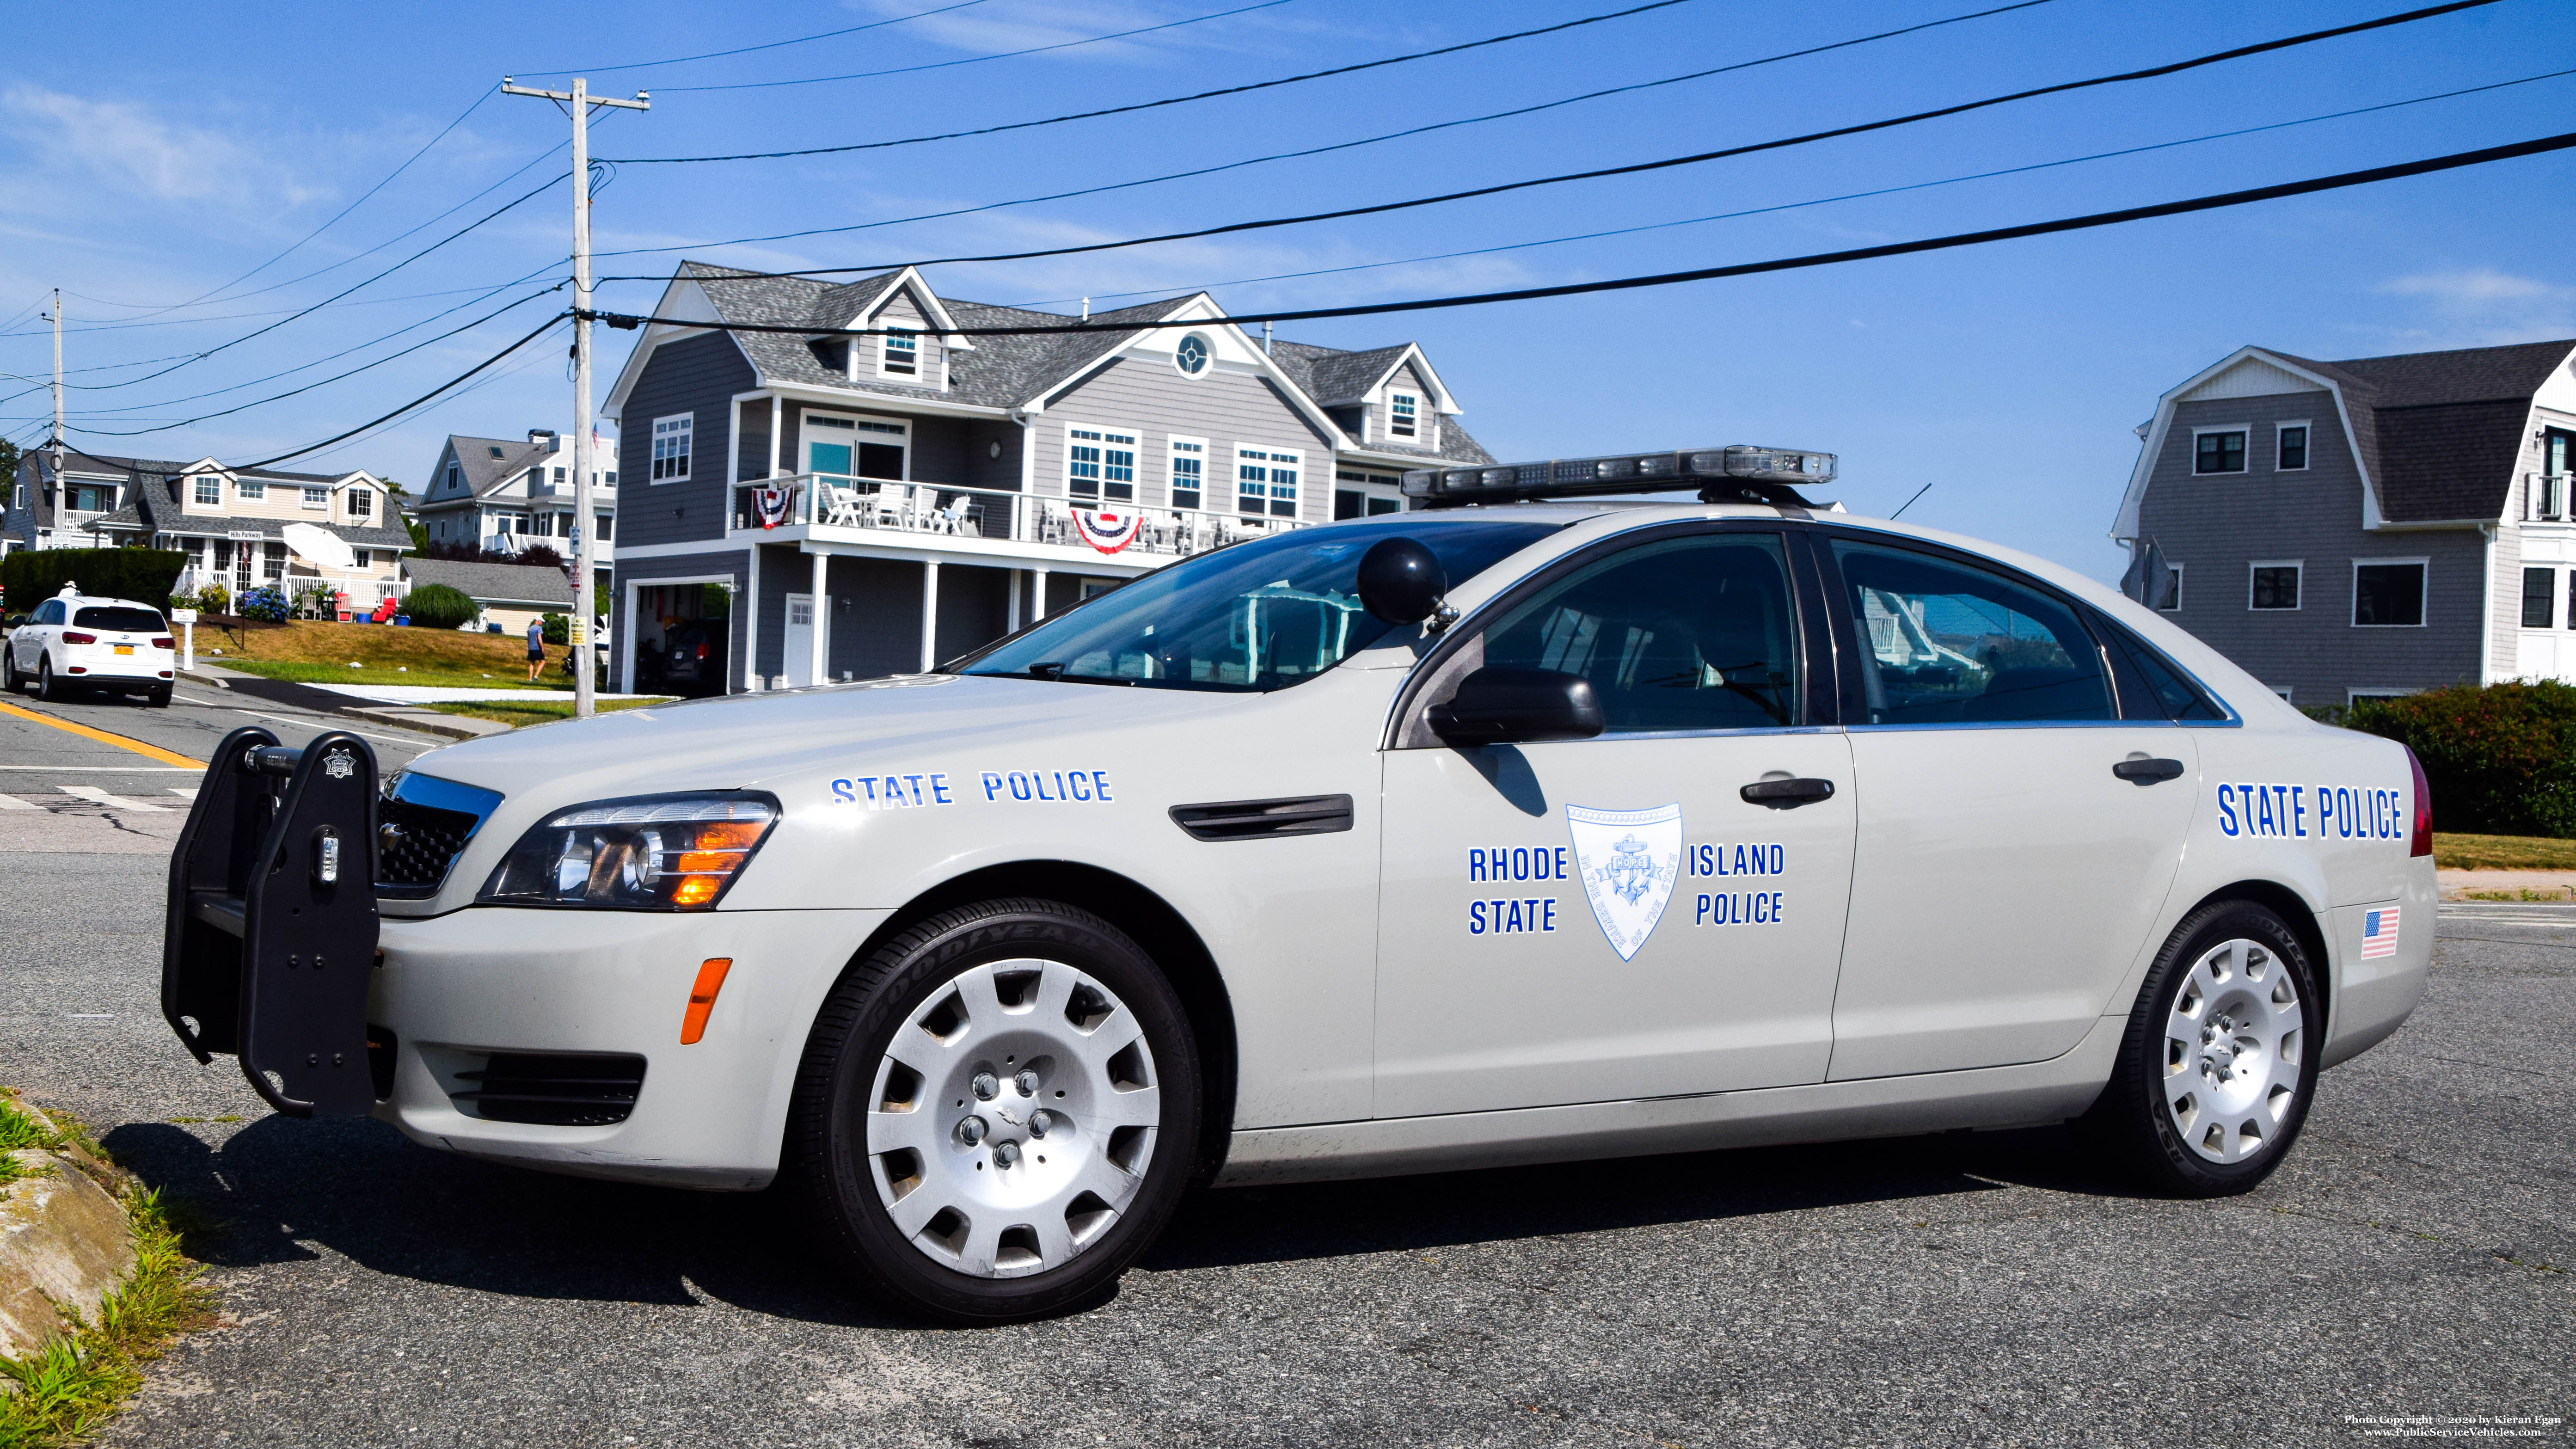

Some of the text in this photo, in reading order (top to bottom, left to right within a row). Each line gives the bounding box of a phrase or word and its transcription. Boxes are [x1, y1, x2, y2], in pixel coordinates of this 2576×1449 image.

[830, 769, 1115, 811] STATE POLICE
[2217, 781, 2404, 841] STATE POLICE
[1468, 843, 1785, 883] RHODE ISLAND
[1617, 858, 1644, 868] HOPE
[1469, 890, 1784, 936] STATE POLICE
[1580, 853, 1678, 949] IN THE SERVICE OF THE STATE
[868, 922, 1101, 1033] GOODYEAR
[2218, 914, 2316, 997] ODYEAR
